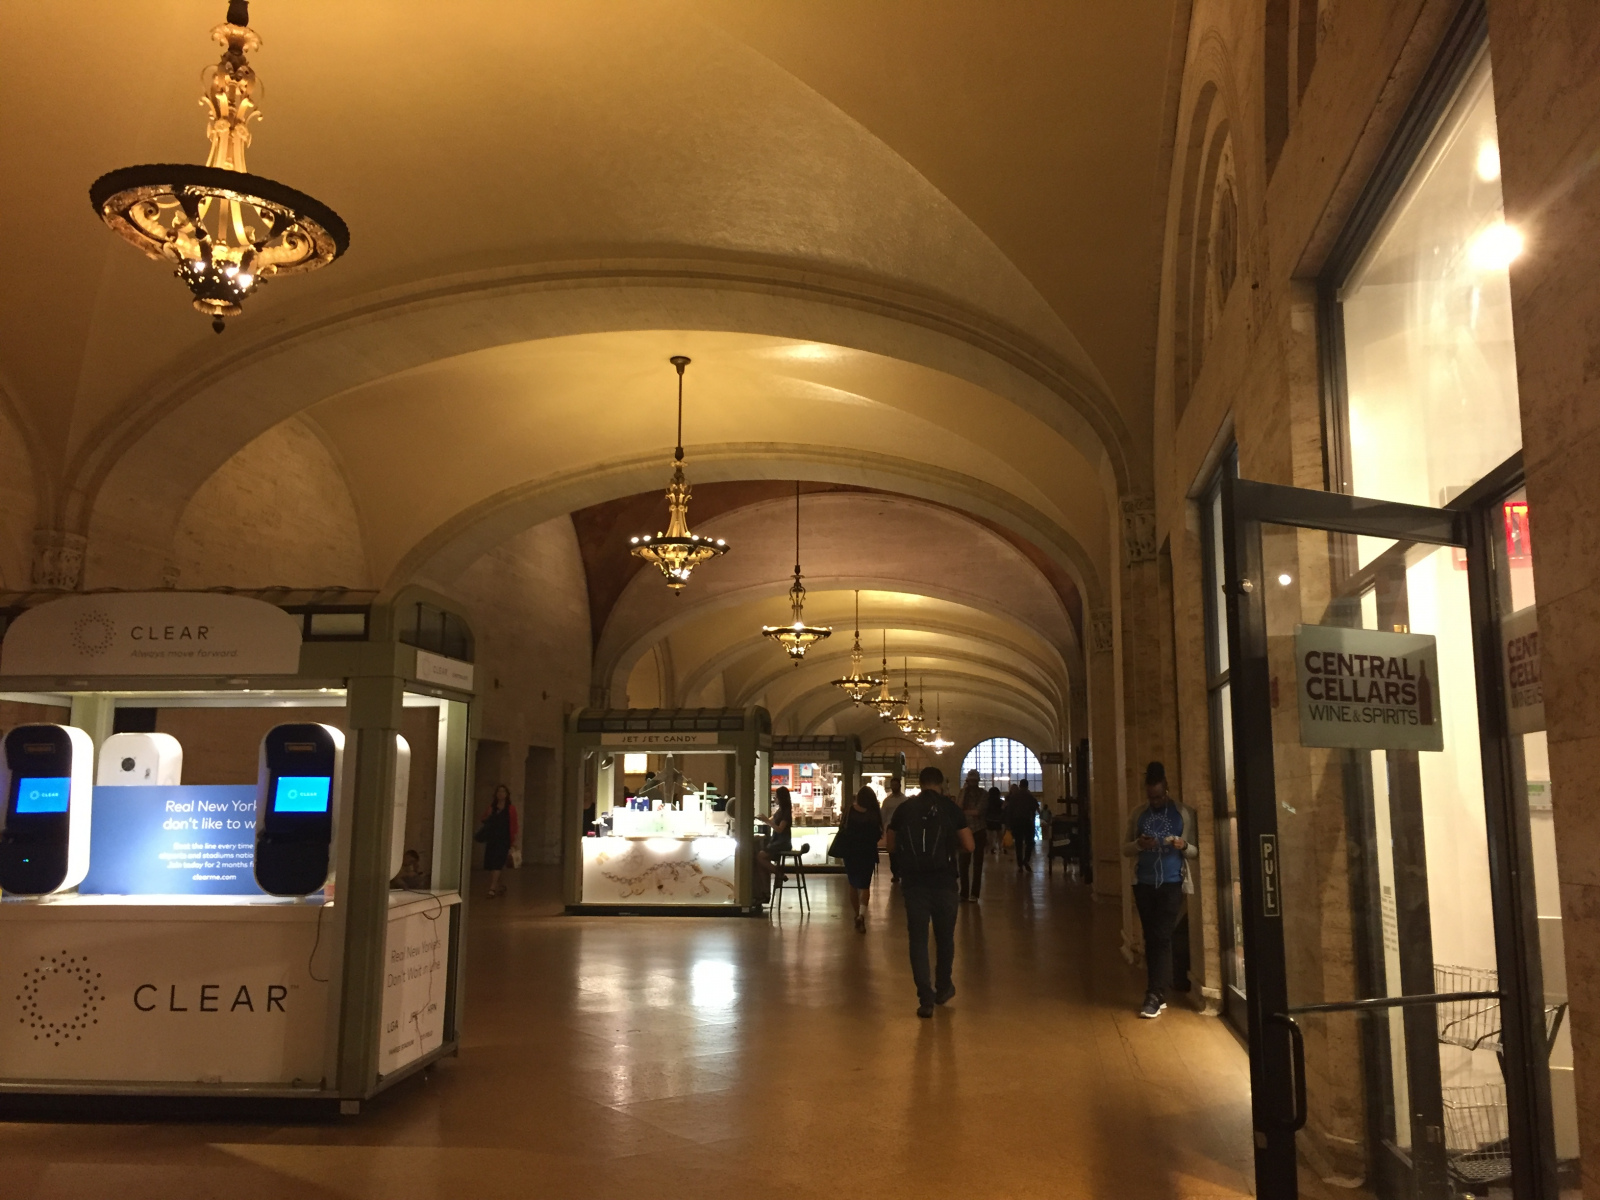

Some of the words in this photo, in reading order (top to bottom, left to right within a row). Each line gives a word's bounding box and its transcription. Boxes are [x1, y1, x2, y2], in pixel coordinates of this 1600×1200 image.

[1505, 505, 1529, 555] IT
[130, 625, 209, 640] CLEAR
[130, 649, 165, 659] Always
[167, 650, 195, 658] move
[1507, 632, 1538, 664] CENT
[1304, 650, 1416, 681] CENTRAL
[1508, 660, 1539, 689] CELL
[1306, 676, 1418, 706] CELLARS
[622, 735, 639, 743] JET
[642, 735, 660, 743] SET
[165, 800, 195, 813] Real
[197, 800, 229, 812] New
[162, 817, 199, 830] don't
[201, 817, 223, 829] like
[226, 818, 241, 829] to
[191, 842, 204, 850] the
[204, 842, 217, 850] line
[183, 861, 204, 870] today
[204, 860, 215, 868] for
[1263, 843, 1275, 908] PULL
[406, 946, 421, 959] New
[133, 983, 288, 1012] CLEAR
